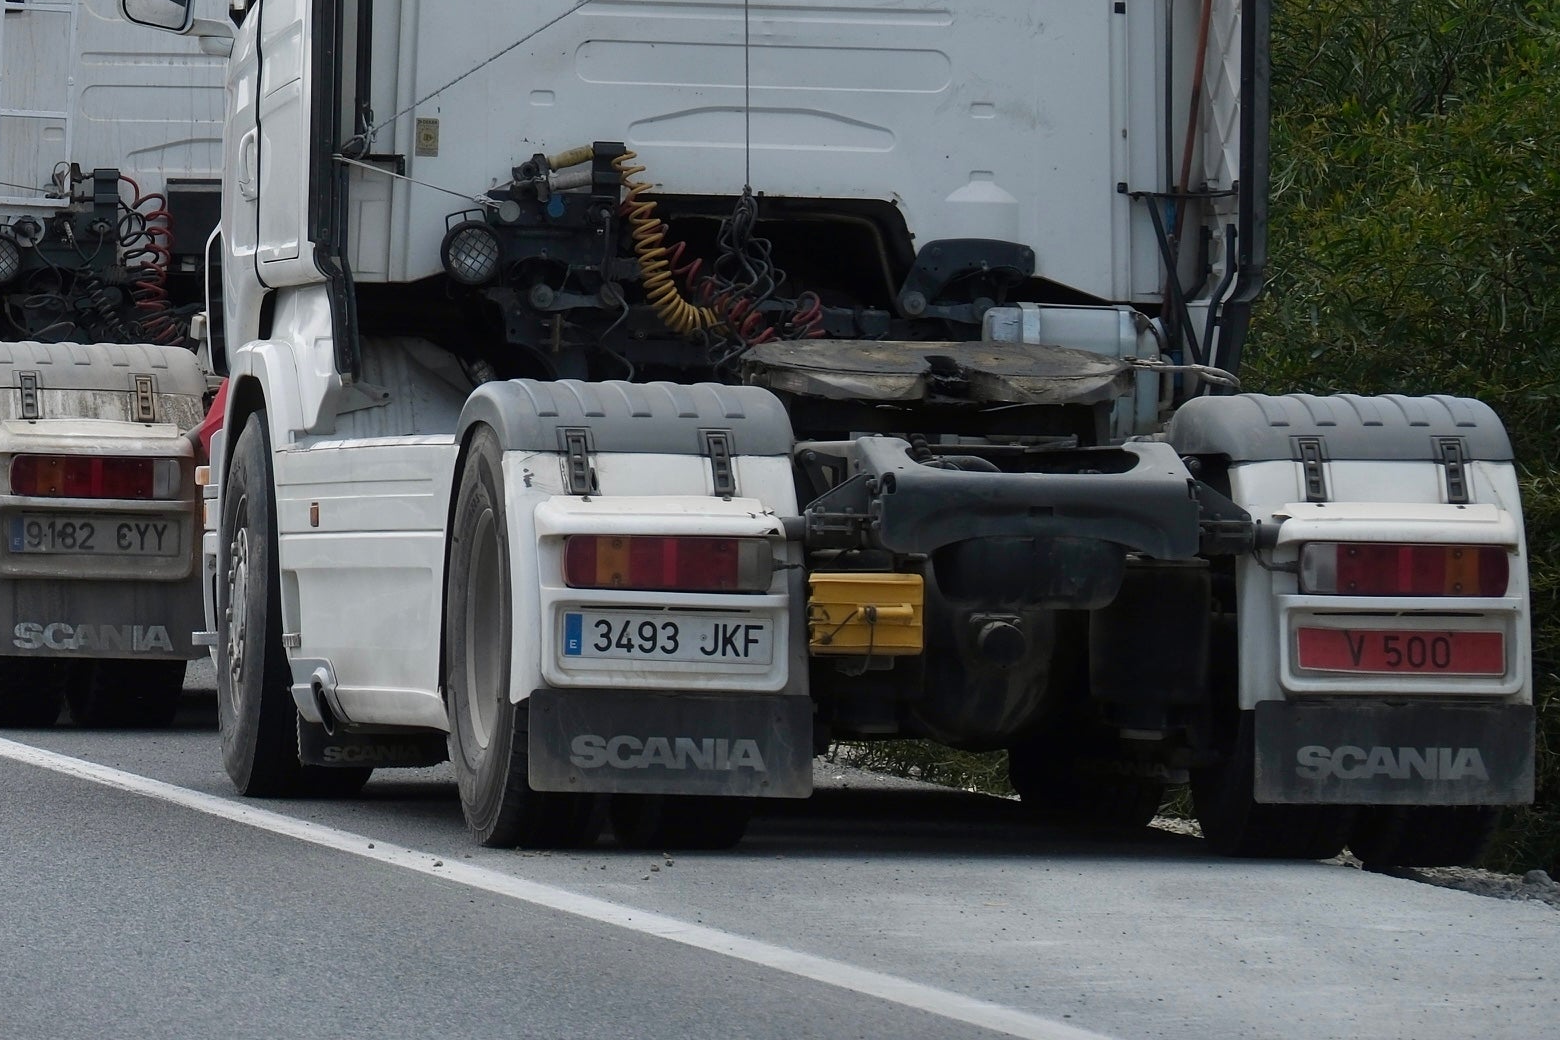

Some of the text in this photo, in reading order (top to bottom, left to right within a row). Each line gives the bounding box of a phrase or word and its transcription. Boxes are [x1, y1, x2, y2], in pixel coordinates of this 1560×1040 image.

[26, 521, 168, 550] 9182 EYY
[13, 622, 173, 652] SCANIA
[570, 640, 577, 649] E
[593, 619, 764, 658] 3493 JKF
[1344, 632, 1452, 669] V 500
[323, 745, 424, 762] SCANIA
[569, 734, 767, 772] SCANIA
[1295, 745, 1489, 781] SCANIA
